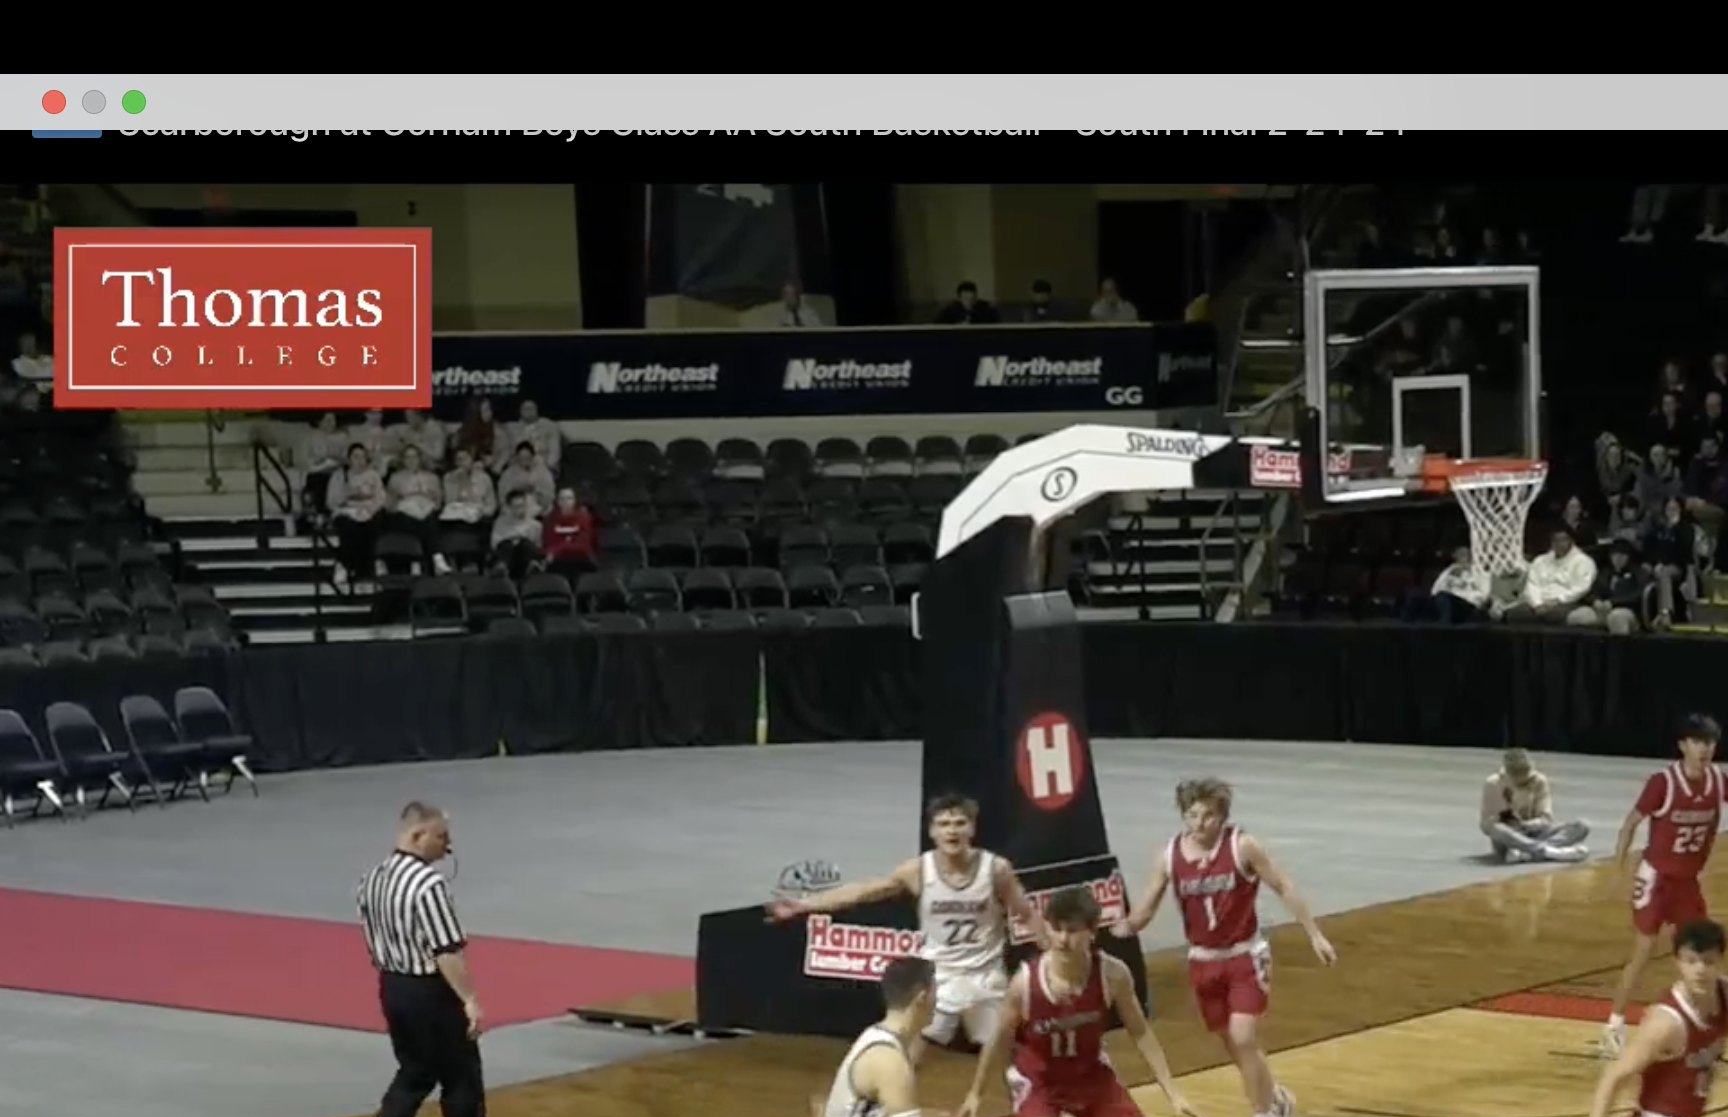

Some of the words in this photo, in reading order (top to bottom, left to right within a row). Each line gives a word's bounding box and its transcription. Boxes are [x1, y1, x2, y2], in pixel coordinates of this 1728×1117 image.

[432, 366, 522, 387] rtheast
[587, 362, 719, 392] Northeast
[783, 359, 912, 390] Northeast
[974, 356, 1102, 386] Northeast
[1105, 387, 1143, 404] GG
[1126, 432, 1209, 457] SPALDING
[1026, 723, 1076, 798] H
[1672, 827, 1706, 854] 23
[1206, 896, 1218, 932] 1
[812, 918, 923, 952] Hammo
[943, 918, 980, 947] 22
[1051, 1029, 1078, 1058] 11
